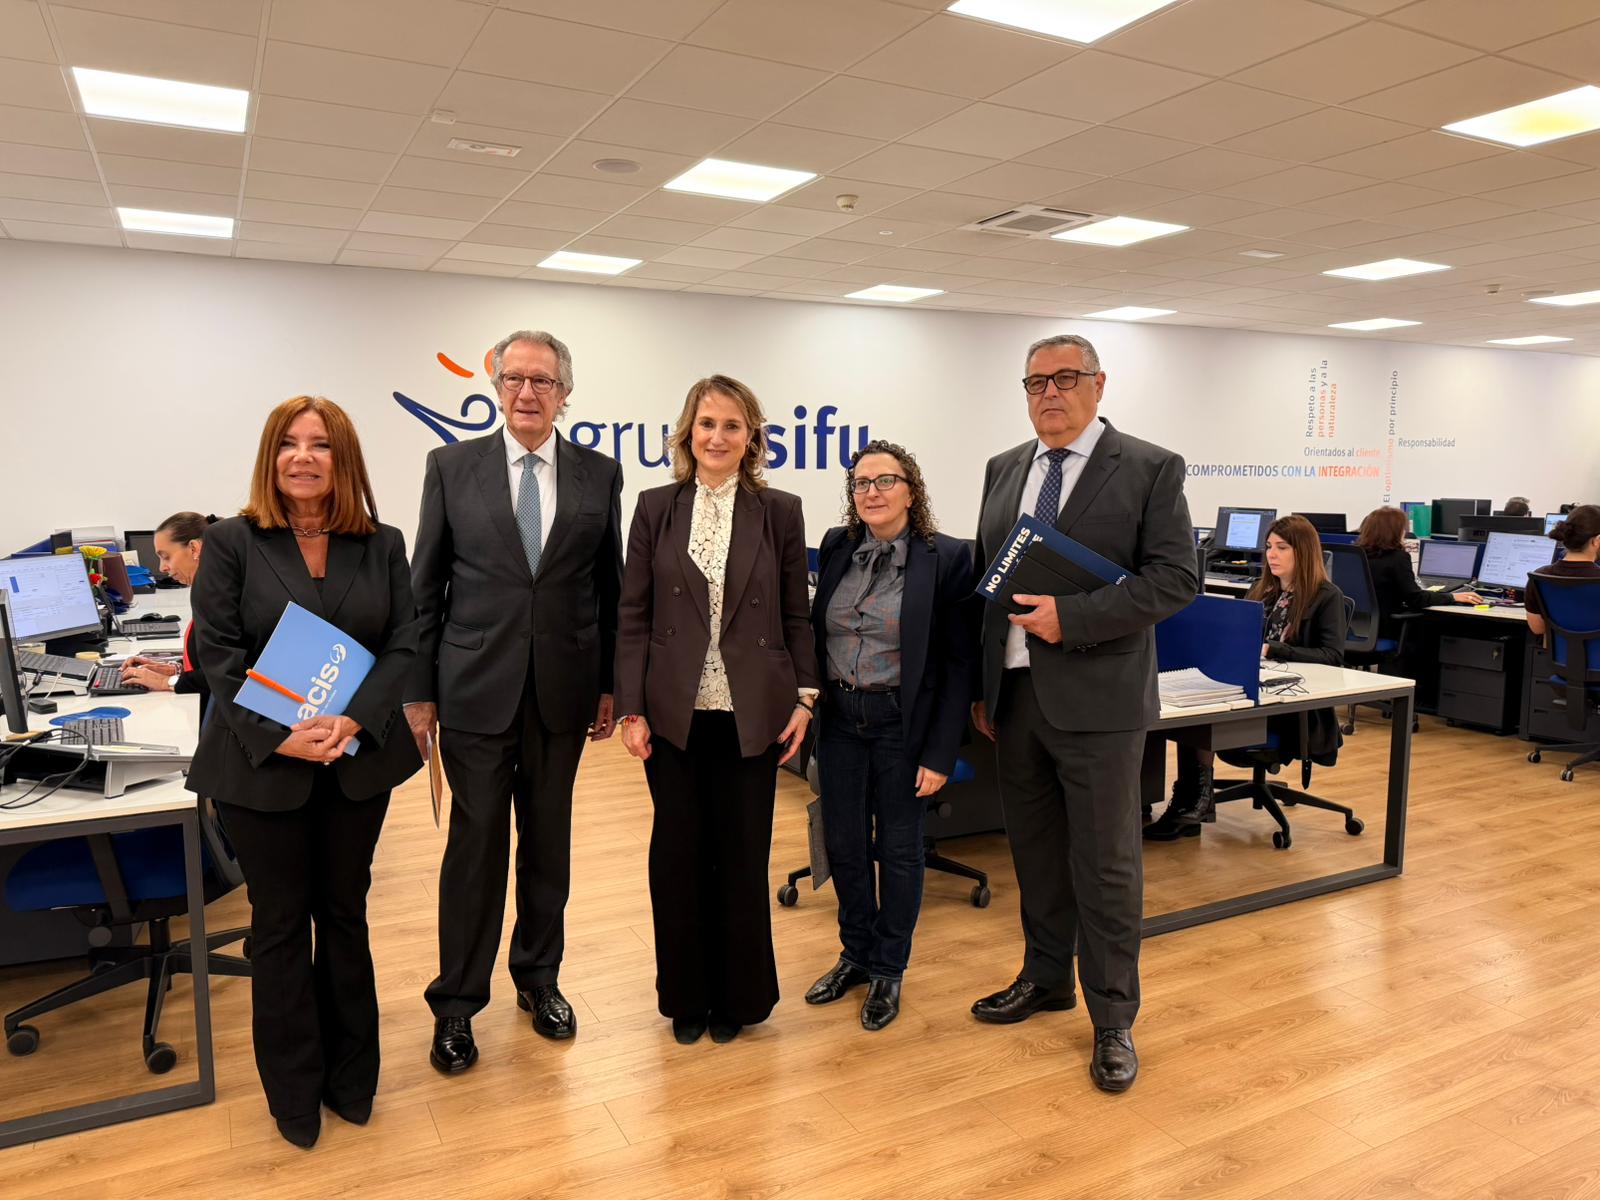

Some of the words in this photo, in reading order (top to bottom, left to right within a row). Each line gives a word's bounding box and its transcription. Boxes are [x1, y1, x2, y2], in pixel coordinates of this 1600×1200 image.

[1320, 359, 1328, 370] la
[1309, 367, 1317, 383] las
[1390, 370, 1399, 416] principio
[1306, 395, 1316, 438] Respeto
[1318, 389, 1327, 438] personas
[1328, 384, 1337, 438] naturaleza
[1388, 419, 1396, 436] por
[1399, 437, 1456, 449] Responsabilidad
[1304, 447, 1346, 457] Orientados
[1347, 447, 1354, 457] al
[1356, 448, 1380, 457] cliente
[1186, 464, 1279, 477] COMPROMETIDOS
[1281, 465, 1302, 477] CON
[1304, 465, 1317, 477] LA
[1318, 463, 1380, 477] INTEGRACIÓN
[1383, 493, 1391, 503] El
[985, 573, 1002, 594] NO
[997, 527, 1031, 574] LIMITES
